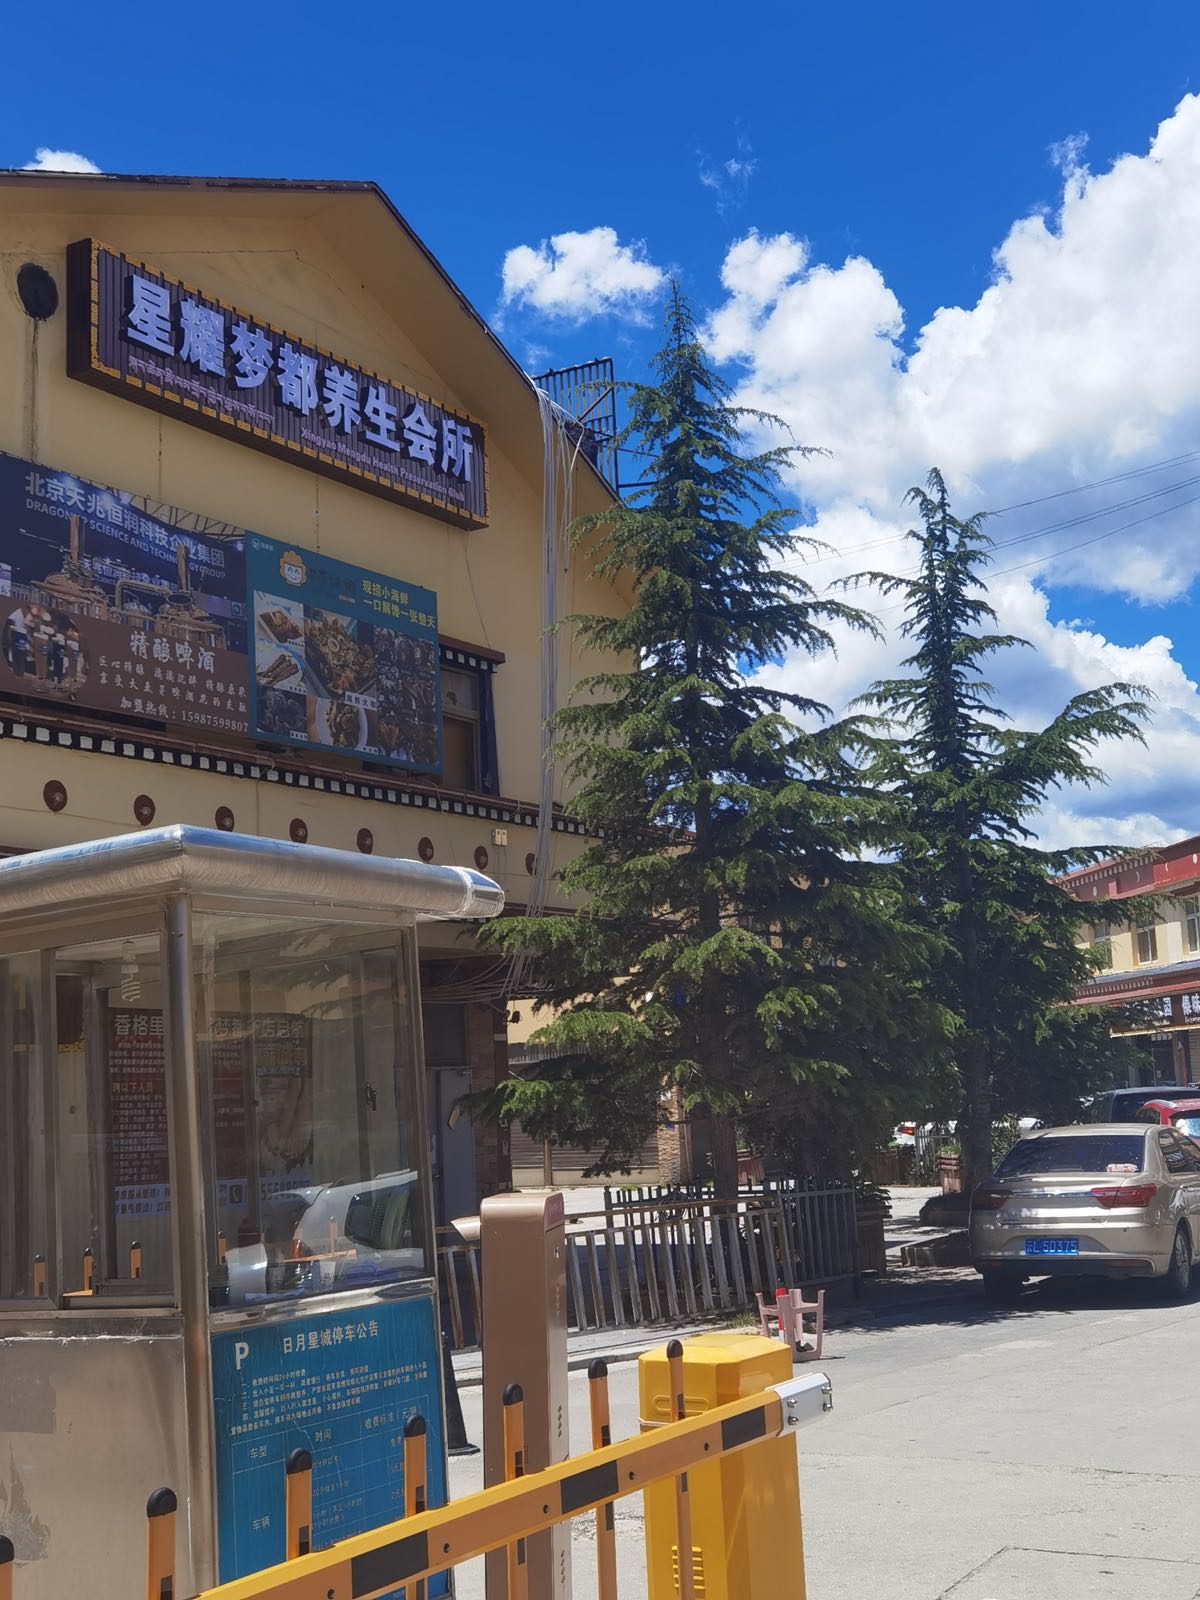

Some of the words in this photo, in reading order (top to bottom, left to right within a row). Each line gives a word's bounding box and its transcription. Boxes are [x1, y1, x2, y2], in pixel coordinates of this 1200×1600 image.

[127, 273, 473, 482] 星耀梦都养生会所
[300, 427, 337, 449] Xingyao
[337, 442, 372, 465] Mengdu
[373, 455, 400, 475] Health
[400, 467, 448, 495] Preservation
[447, 486, 465, 502] Club
[25, 471, 225, 568] 北京天兆恒润科技企业集团
[90, 517, 130, 544] SCIENCE
[130, 538, 149, 553] AND
[150, 546, 199, 572] TECHNGY
[130, 631, 216, 673] 精酿啤酒
[235, 1342, 249, 1370] P
[283, 1319, 379, 1354] 日月星城停车公告
[250, 1444, 268, 1460] 车型
[315, 1428, 332, 1443] 时间
[252, 1514, 271, 1532] 车辆
